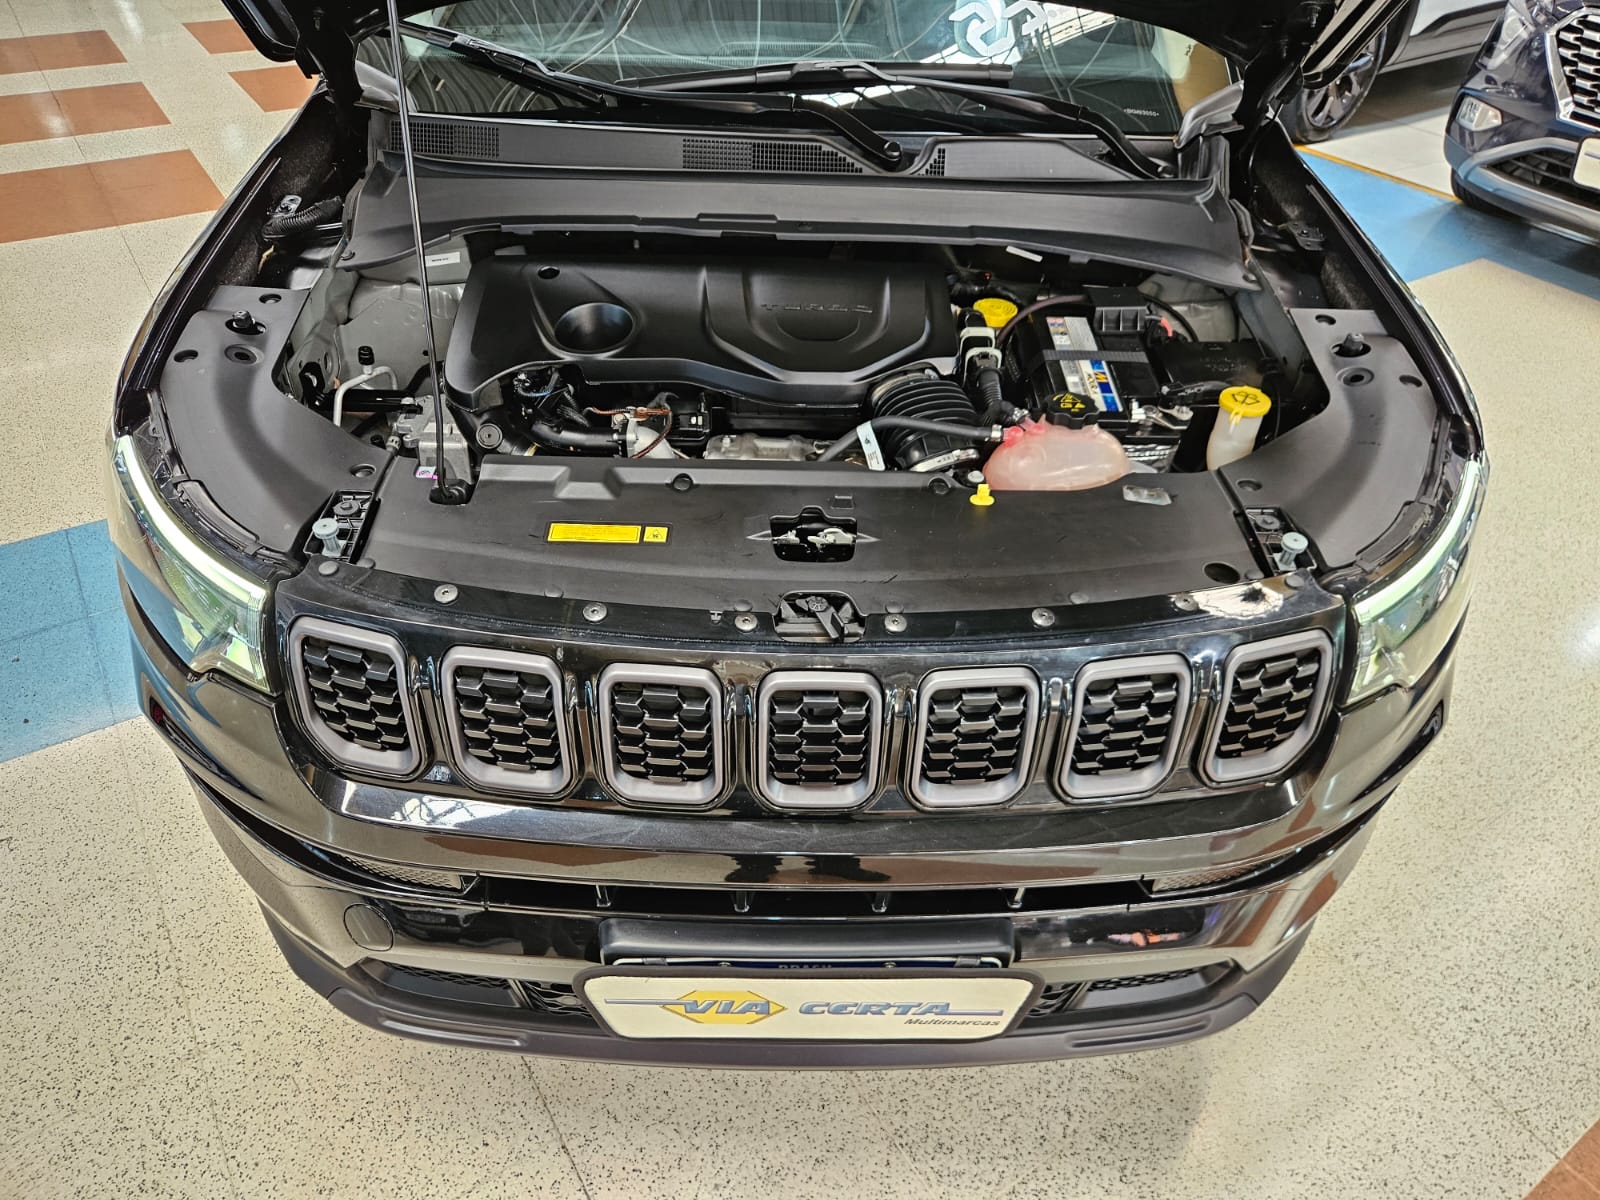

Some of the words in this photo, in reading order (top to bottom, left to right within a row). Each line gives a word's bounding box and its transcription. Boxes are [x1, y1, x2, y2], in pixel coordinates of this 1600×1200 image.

[684, 999, 770, 1015] VIA
[799, 1001, 951, 1016] CERTA
[903, 1017, 1001, 1026] Multimarcas
